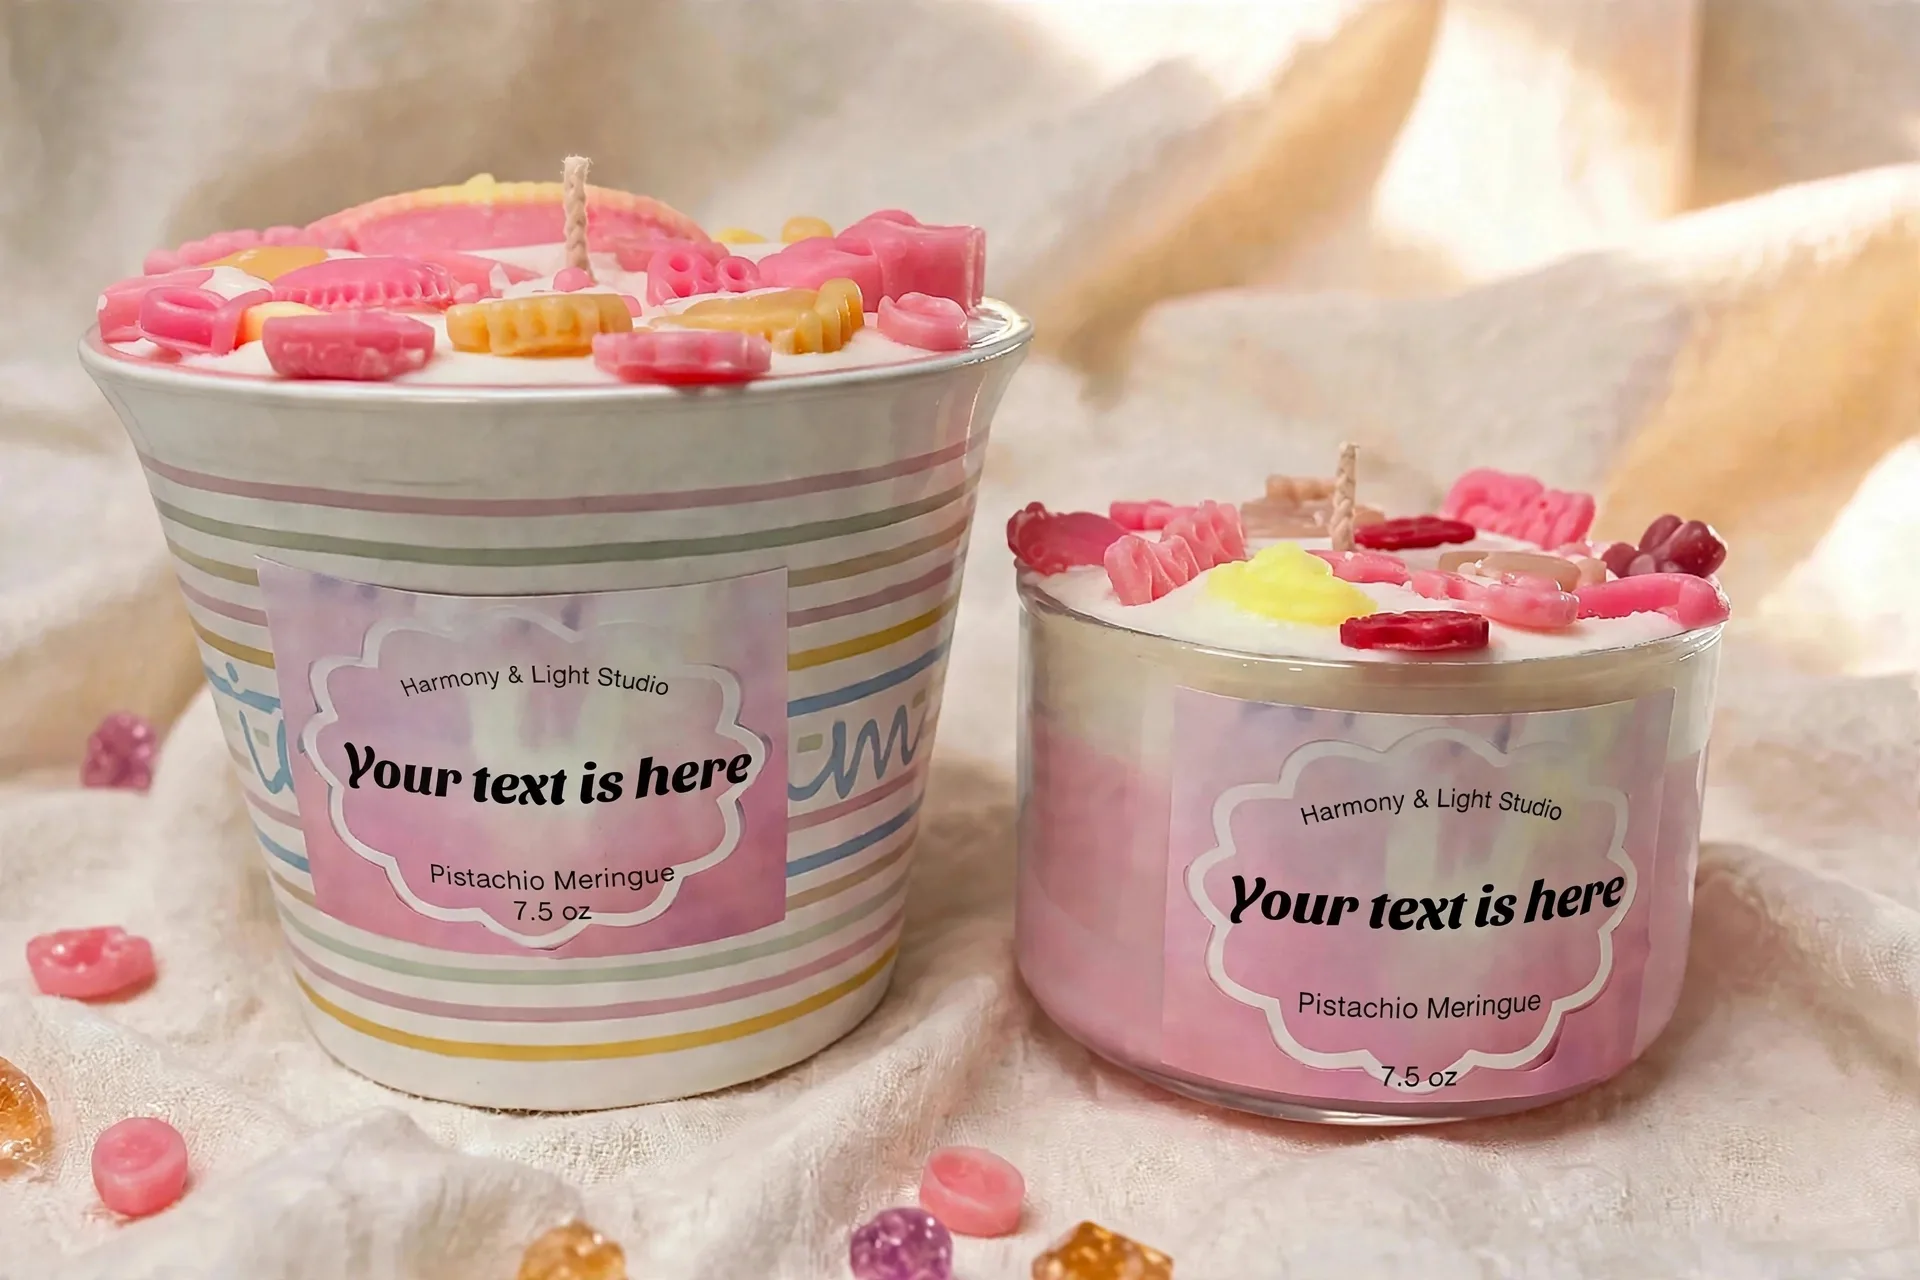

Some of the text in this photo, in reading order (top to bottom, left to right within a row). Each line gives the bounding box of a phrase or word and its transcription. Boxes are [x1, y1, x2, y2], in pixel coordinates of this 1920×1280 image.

[399, 664, 669, 698] Harmony & Light Studio
[343, 741, 463, 798] Your
[471, 766, 568, 806] text
[579, 760, 624, 805] is
[634, 753, 753, 800] here
[1300, 787, 1562, 826] Harmony & Light Studio
[430, 863, 675, 892] Pistachio Meringue
[513, 900, 592, 922] 7.5 oz
[1229, 874, 1625, 931] Your text is here
[1298, 991, 1541, 1021] Pistachio Meringue
[1381, 1065, 1458, 1088] 7.5 oz
